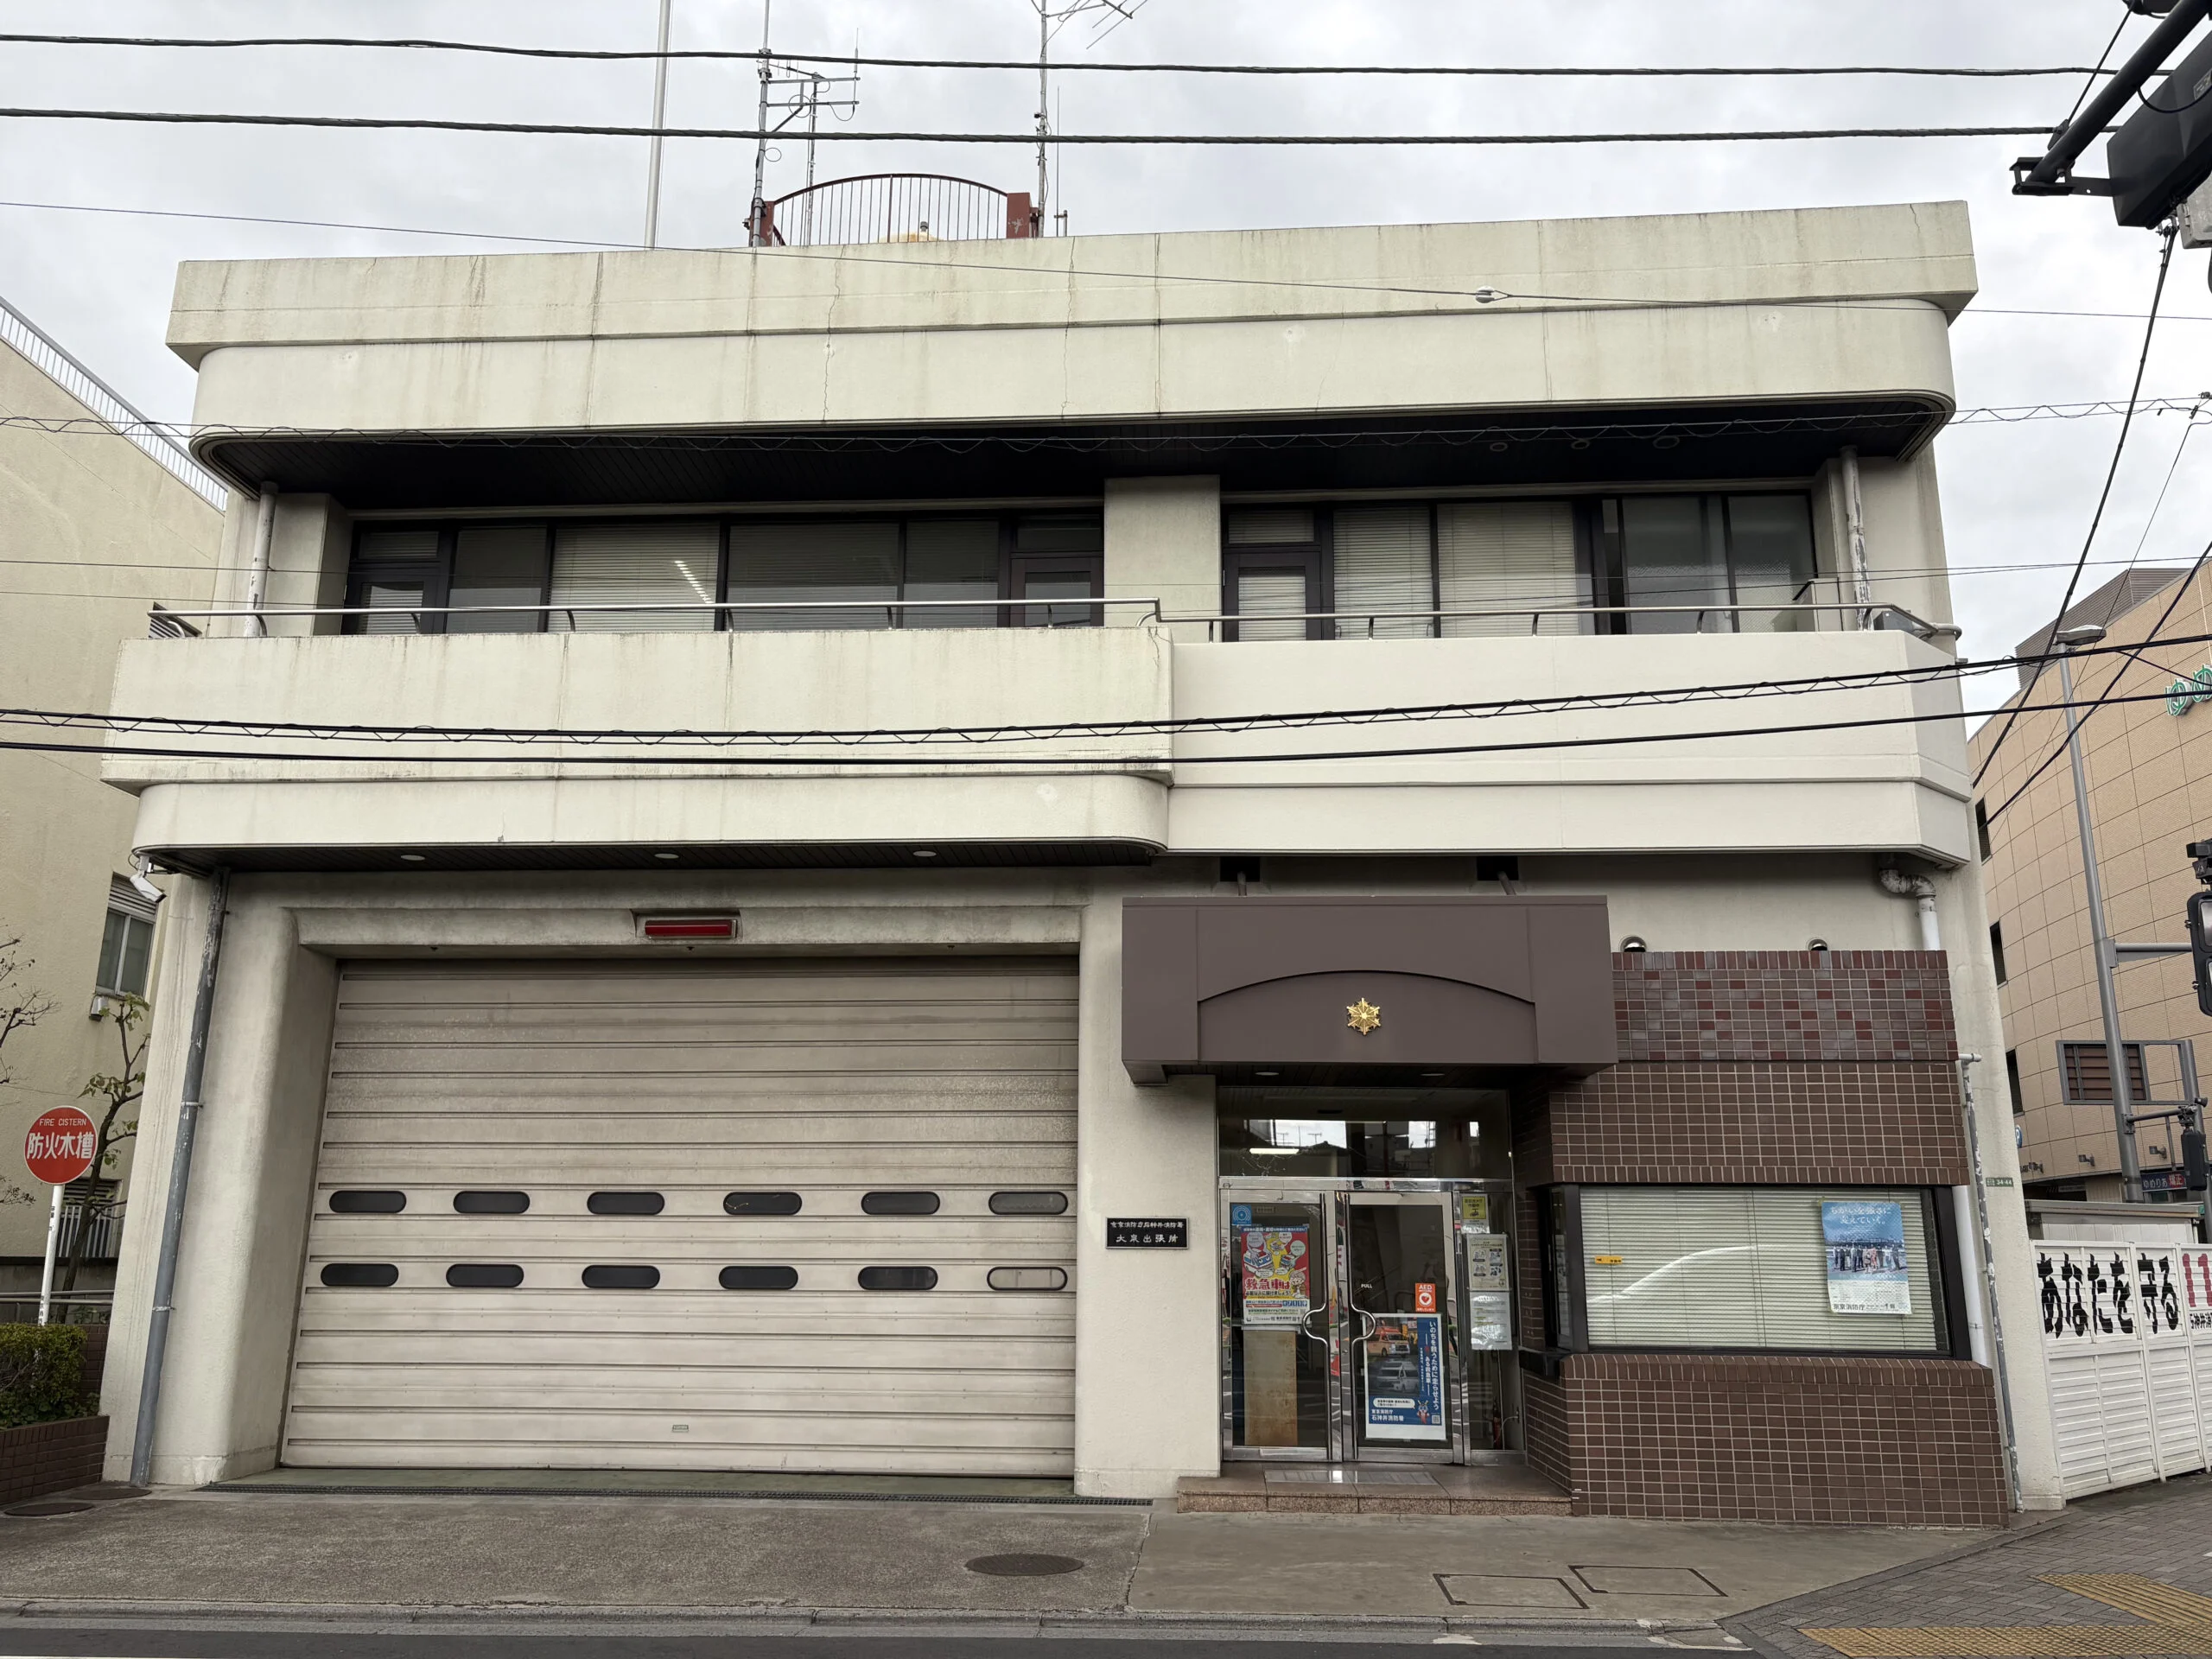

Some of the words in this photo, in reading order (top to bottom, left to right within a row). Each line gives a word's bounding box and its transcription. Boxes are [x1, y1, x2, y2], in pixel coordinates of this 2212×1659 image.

[1116, 1234, 1179, 1243] 大泉出張所
[1244, 1278, 1291, 1291] 救急車は
[2037, 1251, 2180, 1339] あなたを守る
